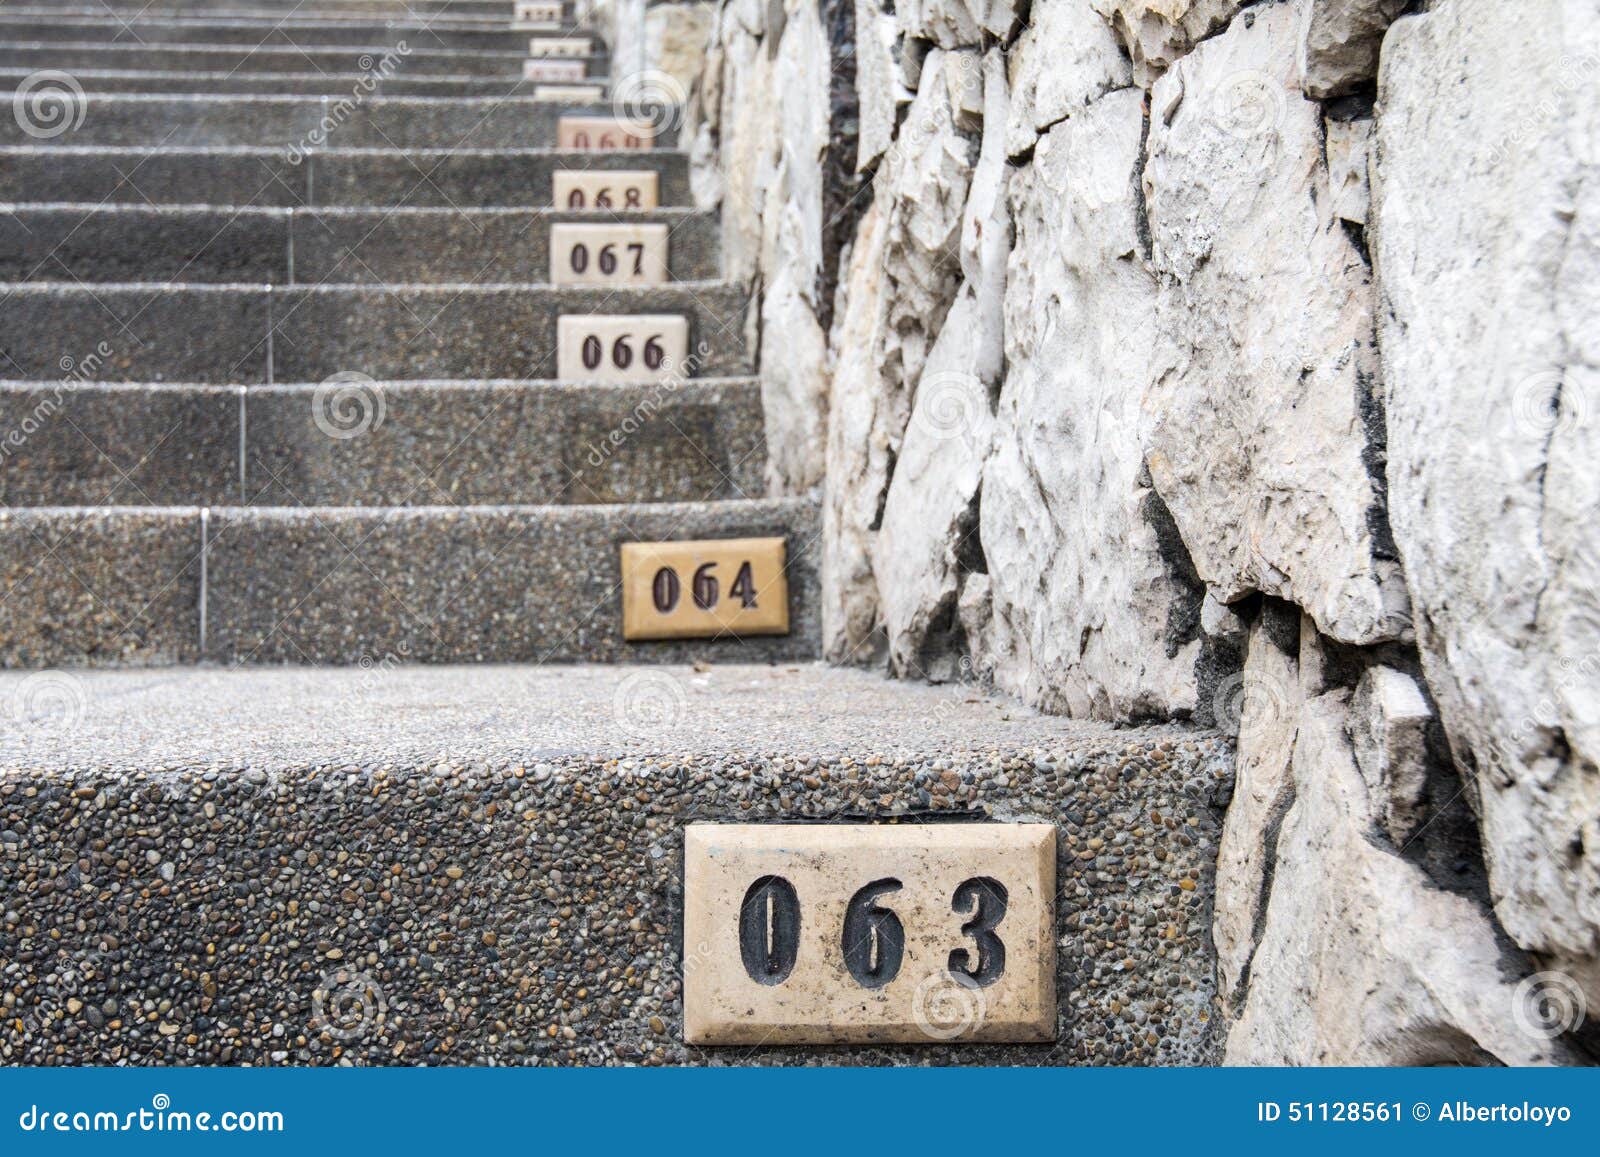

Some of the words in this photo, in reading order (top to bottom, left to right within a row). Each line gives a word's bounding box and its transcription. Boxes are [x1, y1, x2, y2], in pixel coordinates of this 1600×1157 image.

[568, 187, 640, 207] 068
[570, 242, 645, 275] 067
[582, 333, 666, 371] 066
[652, 560, 758, 613] 064
[738, 874, 1009, 990] 063
